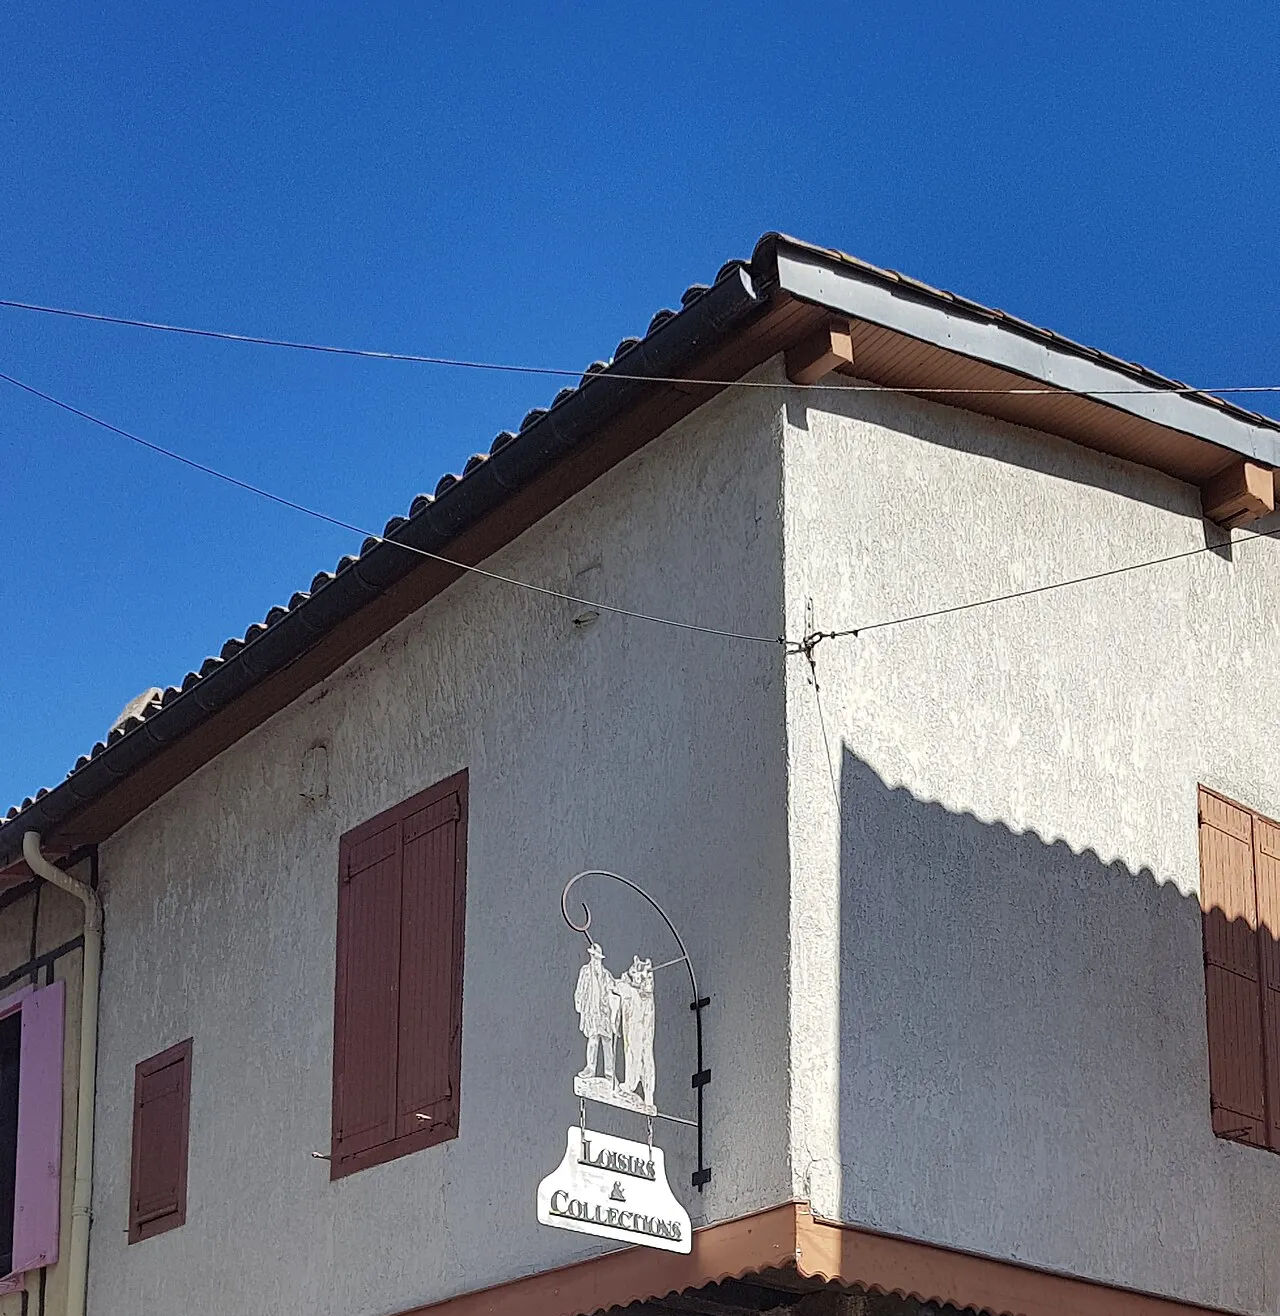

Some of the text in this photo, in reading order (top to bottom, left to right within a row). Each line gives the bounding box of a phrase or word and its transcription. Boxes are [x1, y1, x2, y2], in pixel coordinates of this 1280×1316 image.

[580, 1139, 656, 1179] LOISIRS
[610, 1181, 625, 1201] &
[551, 1190, 682, 1239] COLLECTIONS
